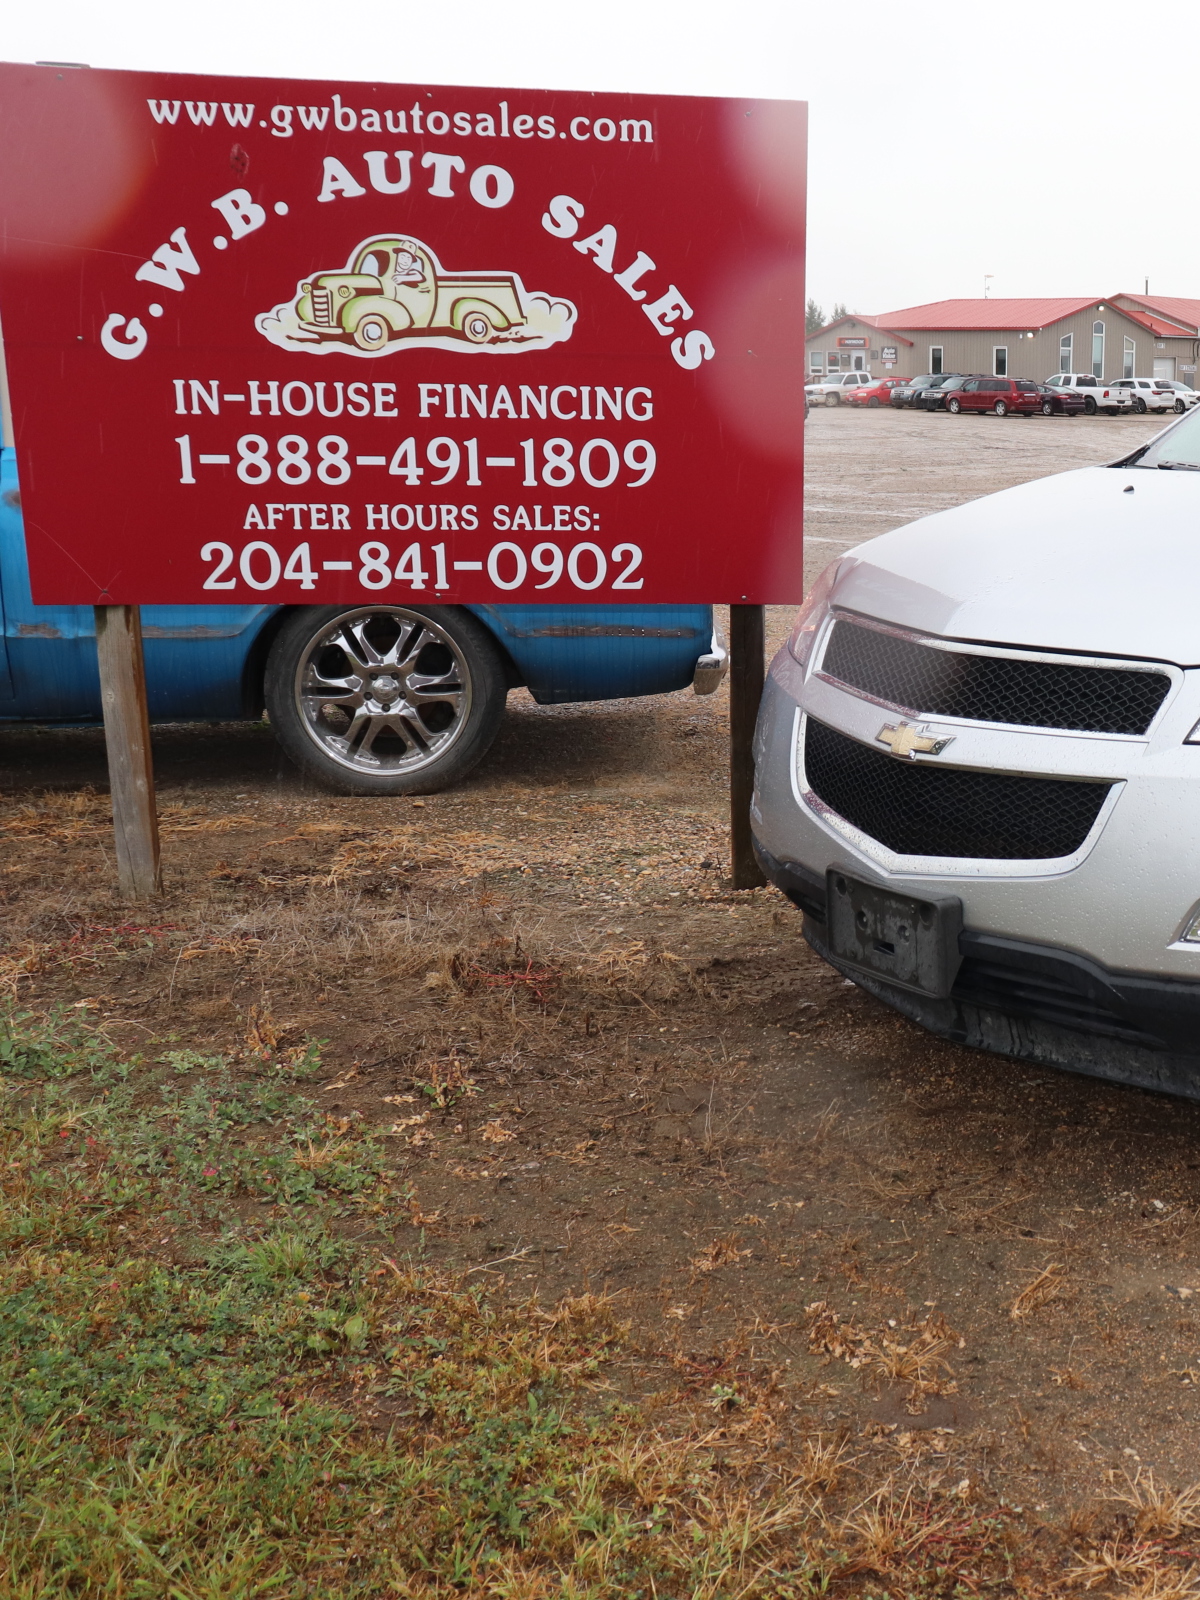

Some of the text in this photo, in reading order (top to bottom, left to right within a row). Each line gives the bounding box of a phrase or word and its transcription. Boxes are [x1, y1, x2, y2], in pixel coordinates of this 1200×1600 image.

[146, 93, 655, 144] www.gwbautosales.com
[316, 150, 515, 209] AUTO
[541, 194, 716, 372] SALES
[172, 379, 654, 422] IN-HOUSE FINANCING
[174, 433, 657, 490] 1-888-491-1809
[242, 503, 600, 532] AFTER HOURS SALES:
[200, 540, 644, 591] 204-841-0902
